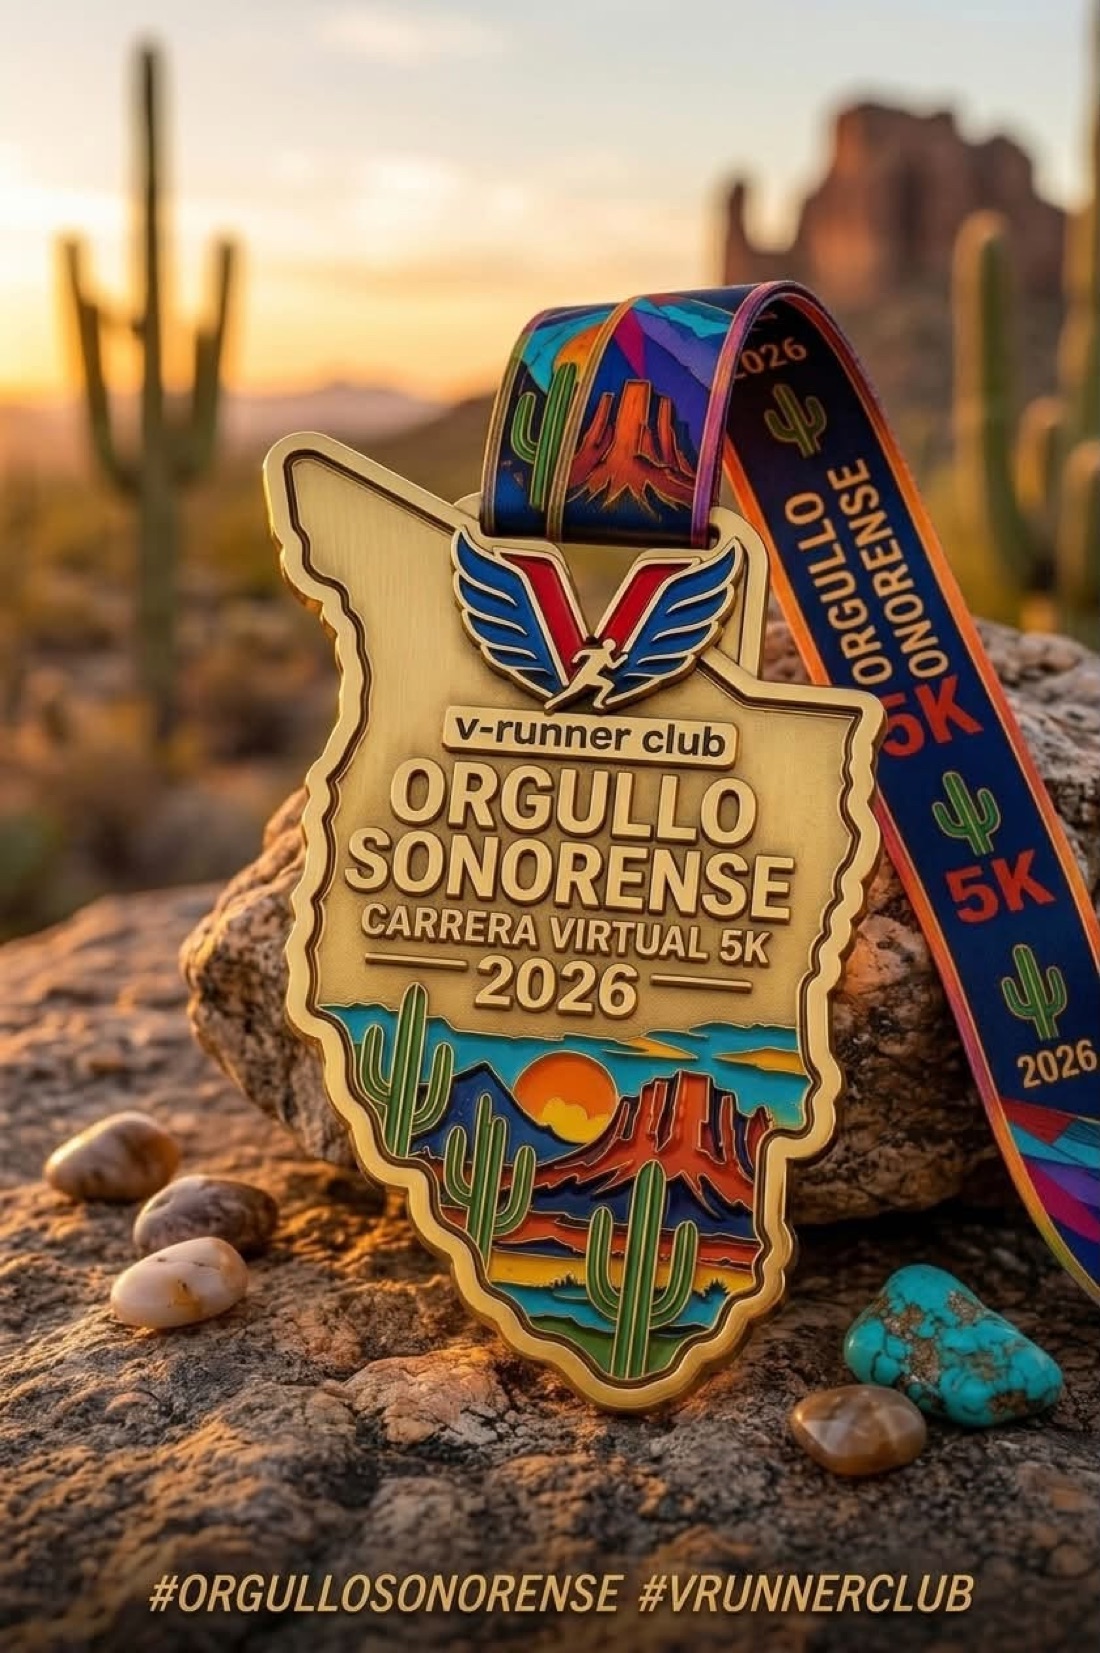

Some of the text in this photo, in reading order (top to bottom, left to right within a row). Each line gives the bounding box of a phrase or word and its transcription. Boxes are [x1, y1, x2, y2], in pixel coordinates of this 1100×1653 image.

[734, 336, 807, 379] 026
[785, 491, 893, 685] ORGULLO
[828, 458, 949, 678] ONORENSE
[455, 715, 726, 757] v-runner club
[880, 674, 984, 757] 5K
[390, 757, 757, 848] ORGULLO
[344, 827, 795, 923] SONORENSE
[945, 849, 1056, 923] 5K
[361, 903, 772, 967] CARRERA VIRTUAL 5K
[475, 955, 639, 1018] 2026
[1017, 1038, 1098, 1089] 2026
